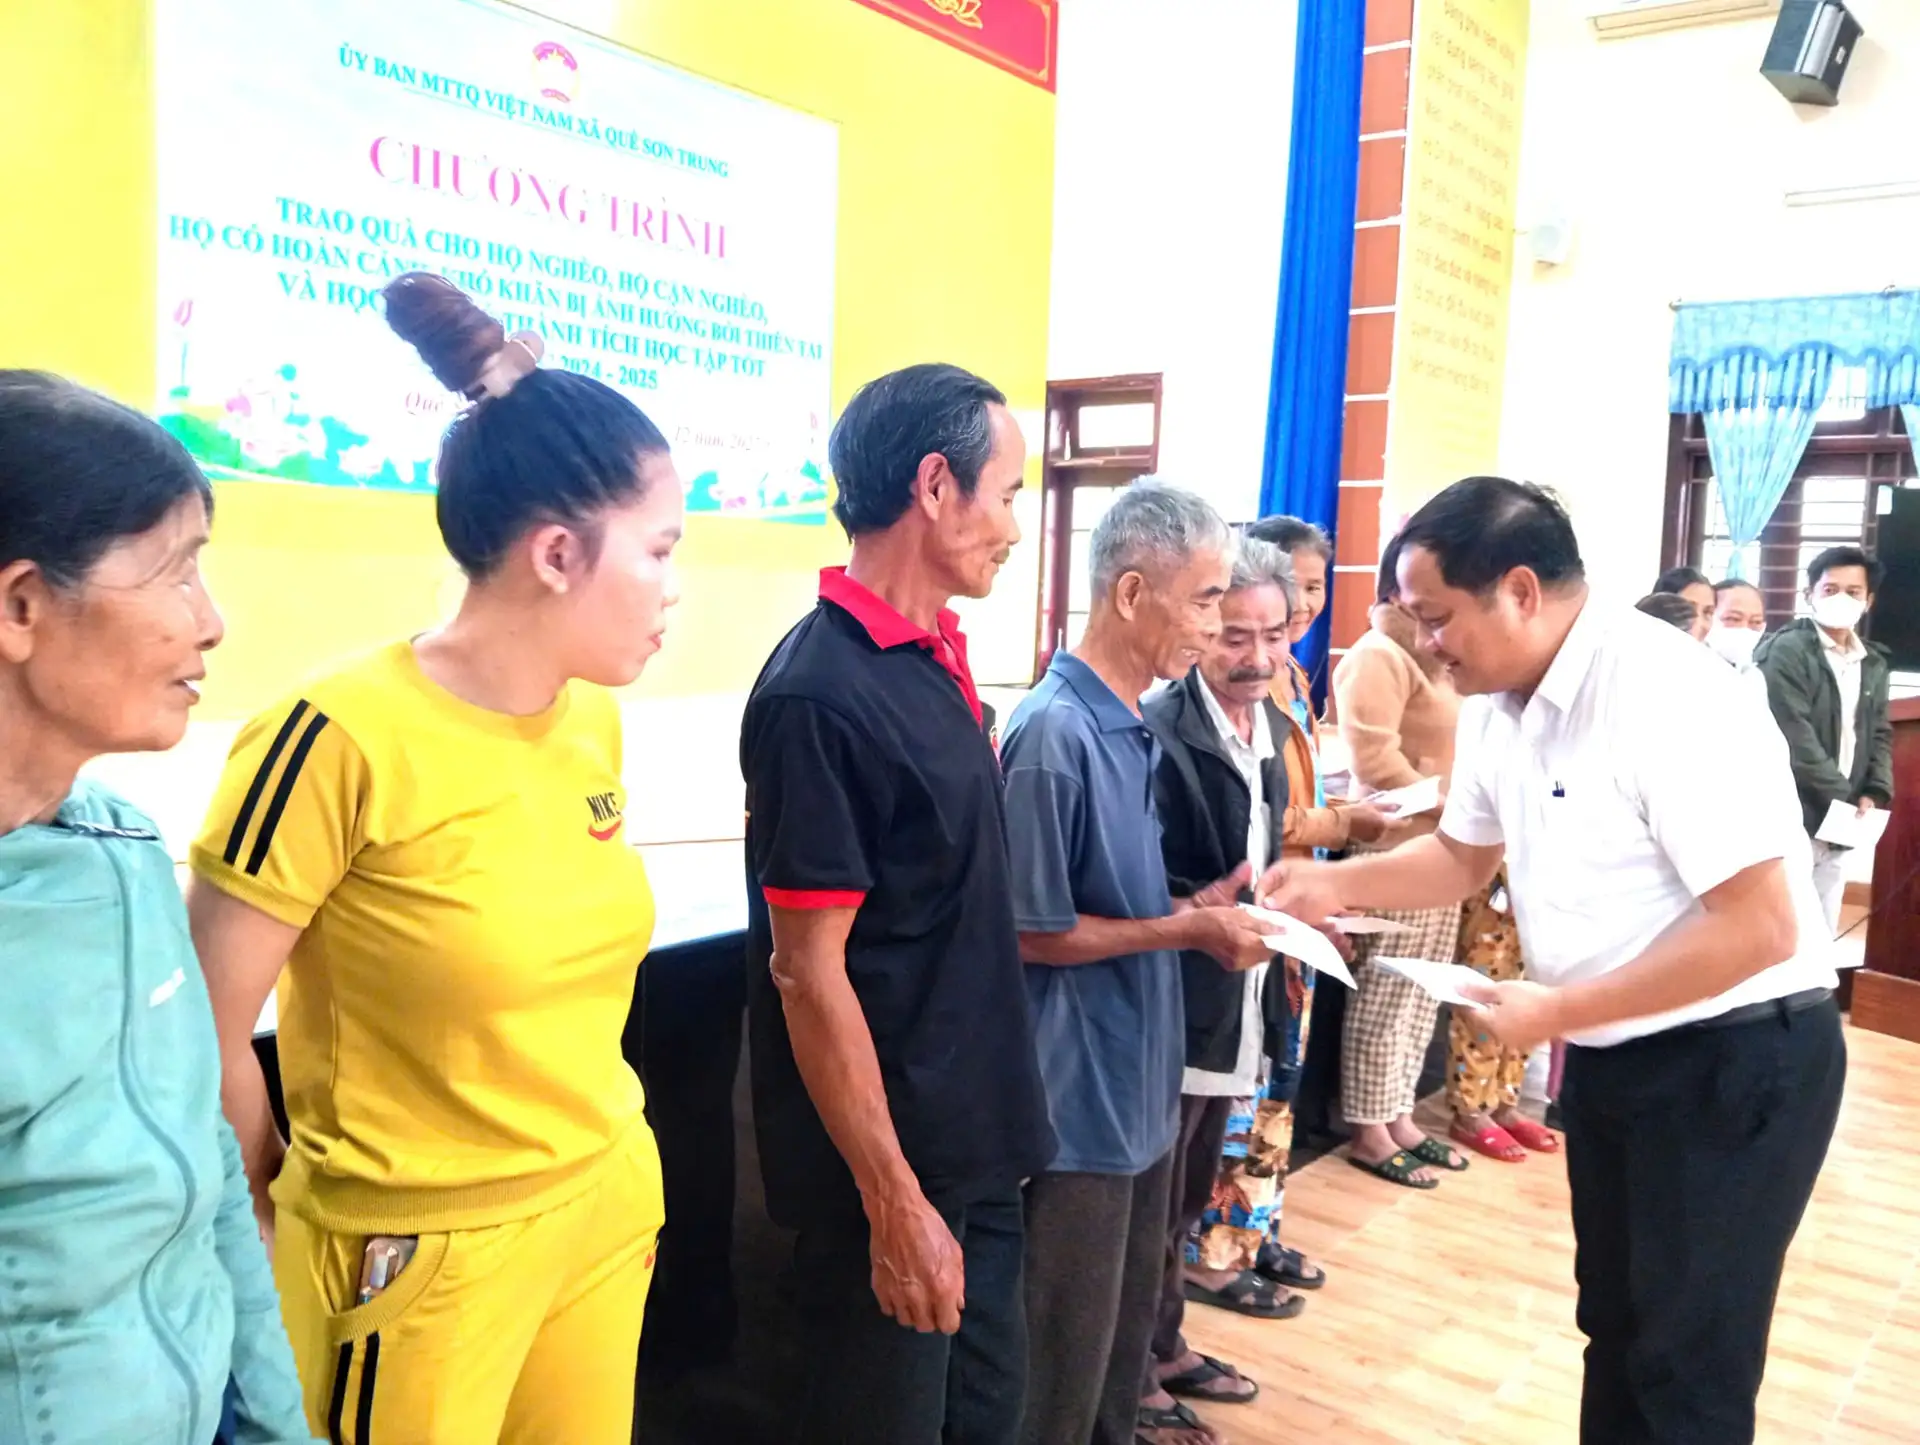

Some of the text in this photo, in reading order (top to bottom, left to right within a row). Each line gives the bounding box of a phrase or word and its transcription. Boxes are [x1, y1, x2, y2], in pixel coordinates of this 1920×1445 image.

[373, 56, 416, 85] BAN
[421, 70, 481, 107] MTTQ
[484, 88, 529, 120] VIỆT
[533, 104, 572, 131] NAM
[676, 147, 729, 178] TRUNG
[169, 214, 215, 250] HỘ
[272, 236, 350, 271] HOÀN
[567, 290, 587, 318] BỊ
[798, 339, 823, 361] TAI
[275, 196, 355, 235] TRAO
[361, 216, 418, 249] QUÀ
[425, 228, 481, 260] CHO
[487, 240, 524, 273] HỘ
[618, 270, 649, 299] HỘ
[277, 269, 317, 301] VÀ
[588, 323, 640, 358] TÍCH
[645, 338, 688, 365] HỌC
[618, 364, 658, 390] 2025
